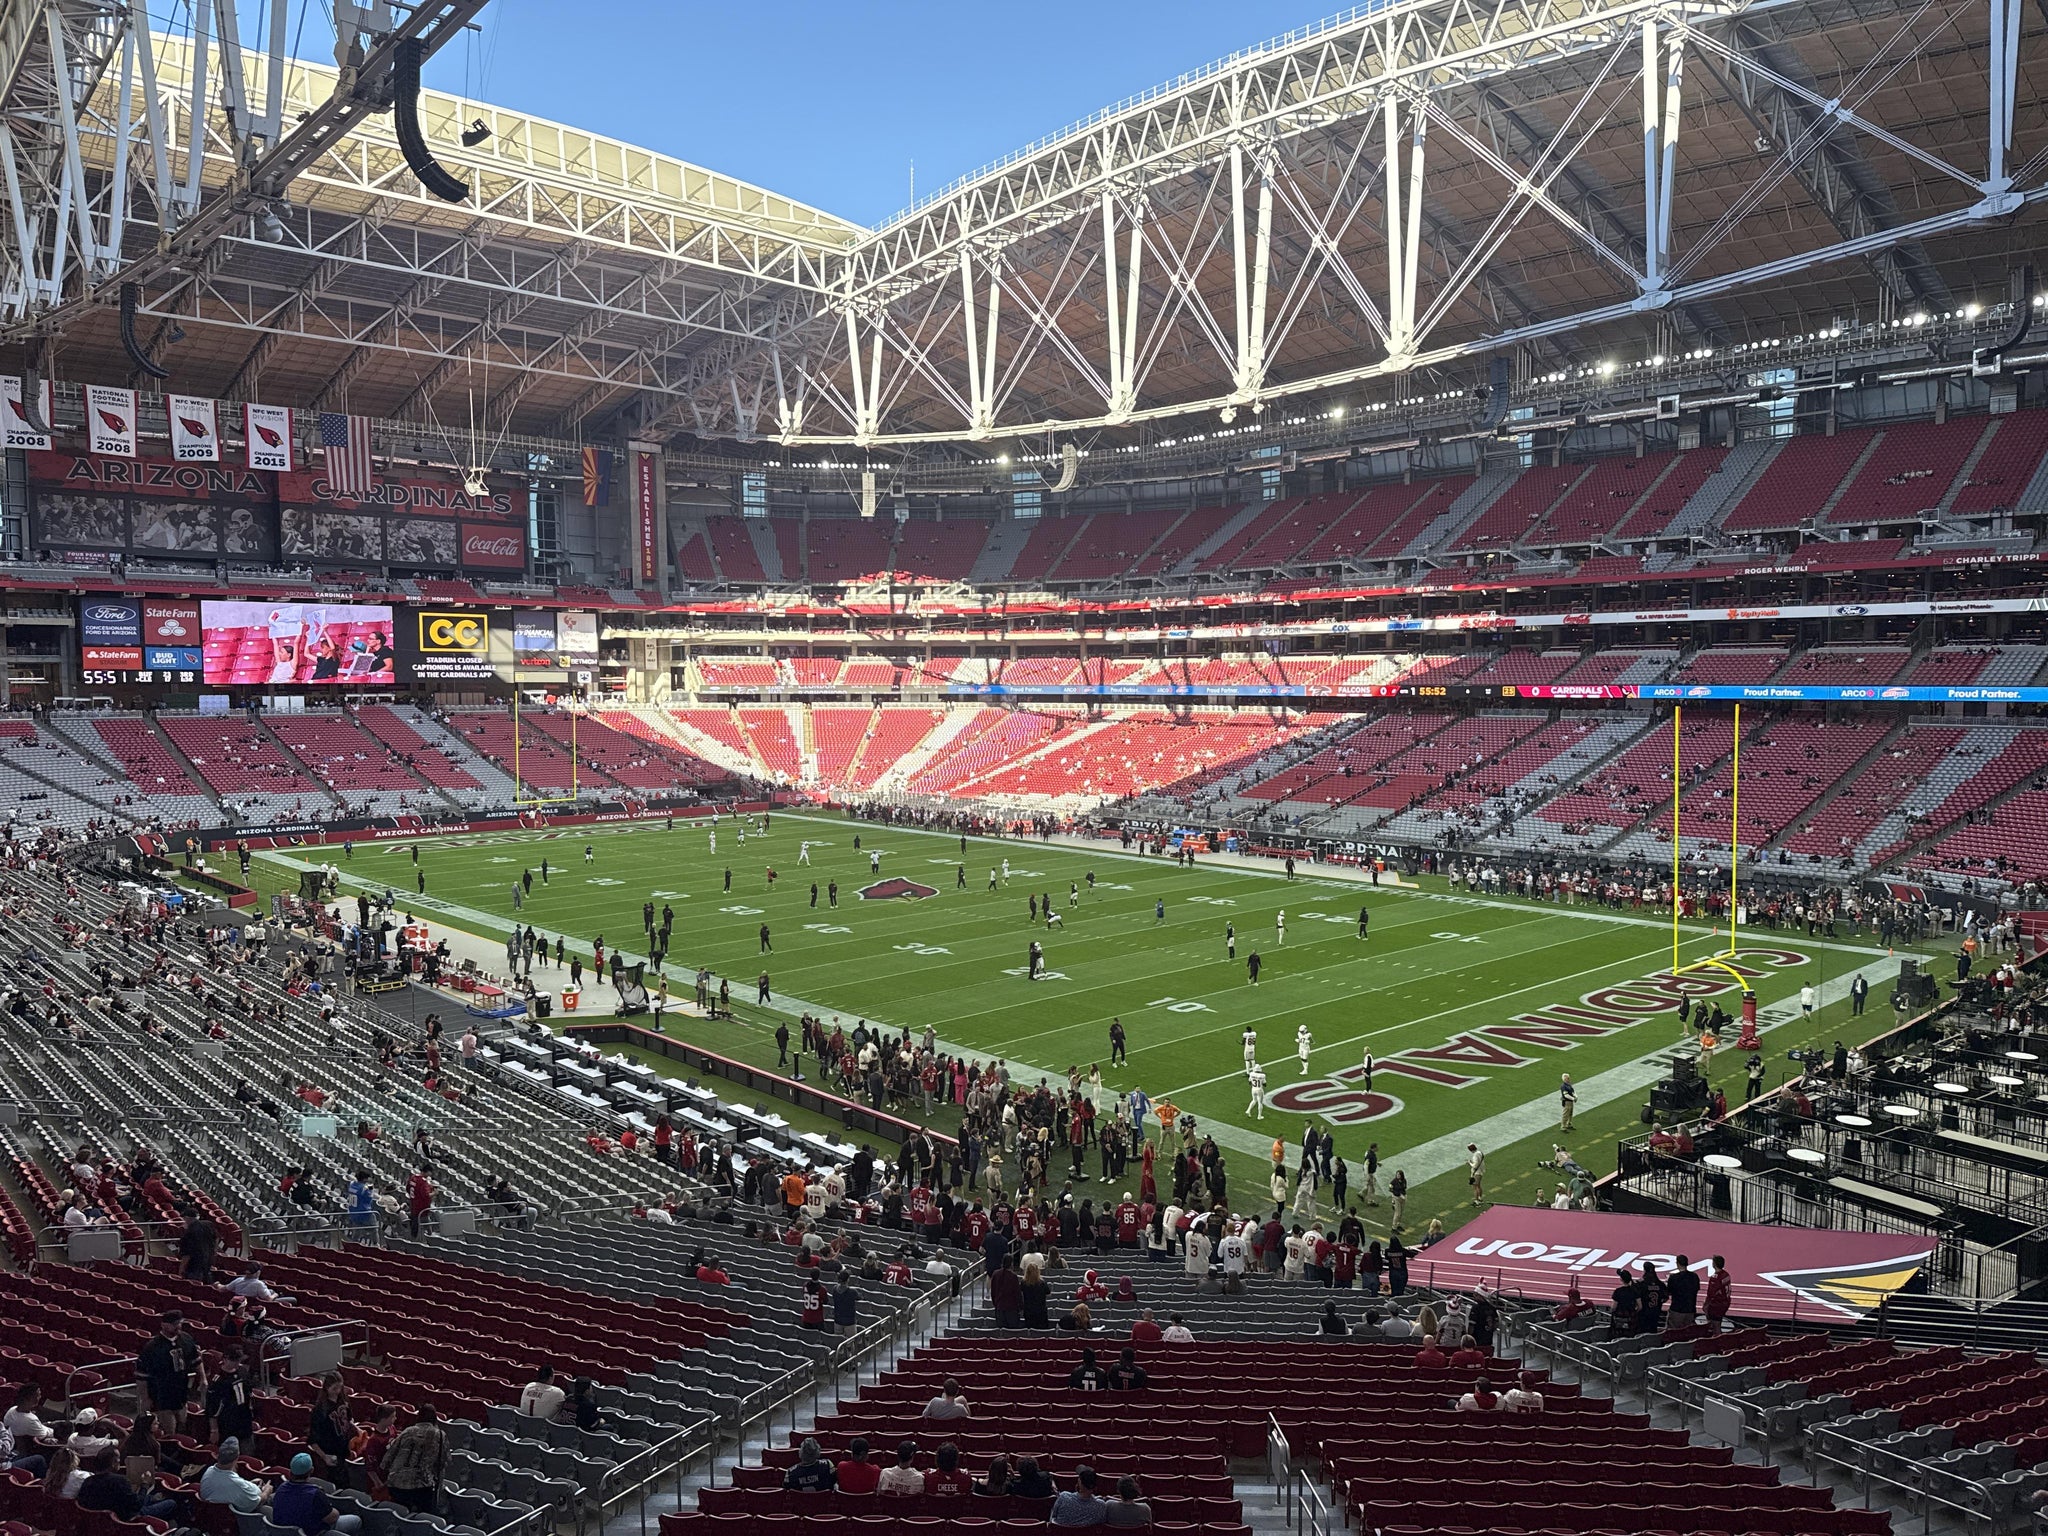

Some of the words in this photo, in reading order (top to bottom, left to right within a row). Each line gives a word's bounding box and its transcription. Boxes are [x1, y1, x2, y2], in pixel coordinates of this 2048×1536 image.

[92, 389, 129, 398] NATIONAL
[92, 395, 130, 403] FOOTBALL
[175, 404, 210, 413] DIVISION
[252, 414, 285, 422] DIVISION
[7, 435, 45, 446] 2008
[97, 441, 131, 453] 2008
[179, 449, 213, 457] 2009
[254, 456, 286, 467] 2015
[66, 456, 266, 494] ARIZONA
[465, 536, 520, 556] Coca-Cola
[1956, 556, 2003, 564] CHARLEY
[95, 607, 126, 620] Ford
[146, 608, 170, 618] State
[170, 609, 197, 618] Farm
[1472, 619, 1495, 628] State
[1496, 618, 1516, 627] Farm
[429, 619, 479, 646] CC
[100, 650, 119, 658] State
[1532, 687, 1539, 696] 0
[1551, 687, 1602, 695] CARDINALS
[1948, 689, 1978, 698] Proud
[1981, 689, 2021, 698] Partner.
[375, 828, 417, 837] ARIZONA
[719, 905, 765, 916] 50
[802, 923, 852, 934] 40
[892, 942, 950, 955] 30
[566, 996, 574, 1004] G
[1146, 997, 1208, 1013] 10
[1264, 947, 1812, 1126] CARDINALS
[1252, 1079, 1261, 1088] 31
[826, 1184, 838, 1195] 40
[808, 1195, 820, 1206] 40
[913, 1199, 926, 1212] 55
[1019, 1218, 1028, 1229] 18
[1124, 1213, 1135, 1224] 85
[972, 1225, 979, 1236] 0
[1191, 1244, 1198, 1257] 3
[1228, 1248, 1241, 1258] 58
[1289, 1247, 1299, 1259] 18
[1343, 1253, 1347, 1265] 1
[1454, 1236, 1718, 1278] verizon
[887, 1272, 897, 1283] 21
[1082, 1380, 1096, 1390] 11
[938, 1484, 958, 1492] CHEESE
